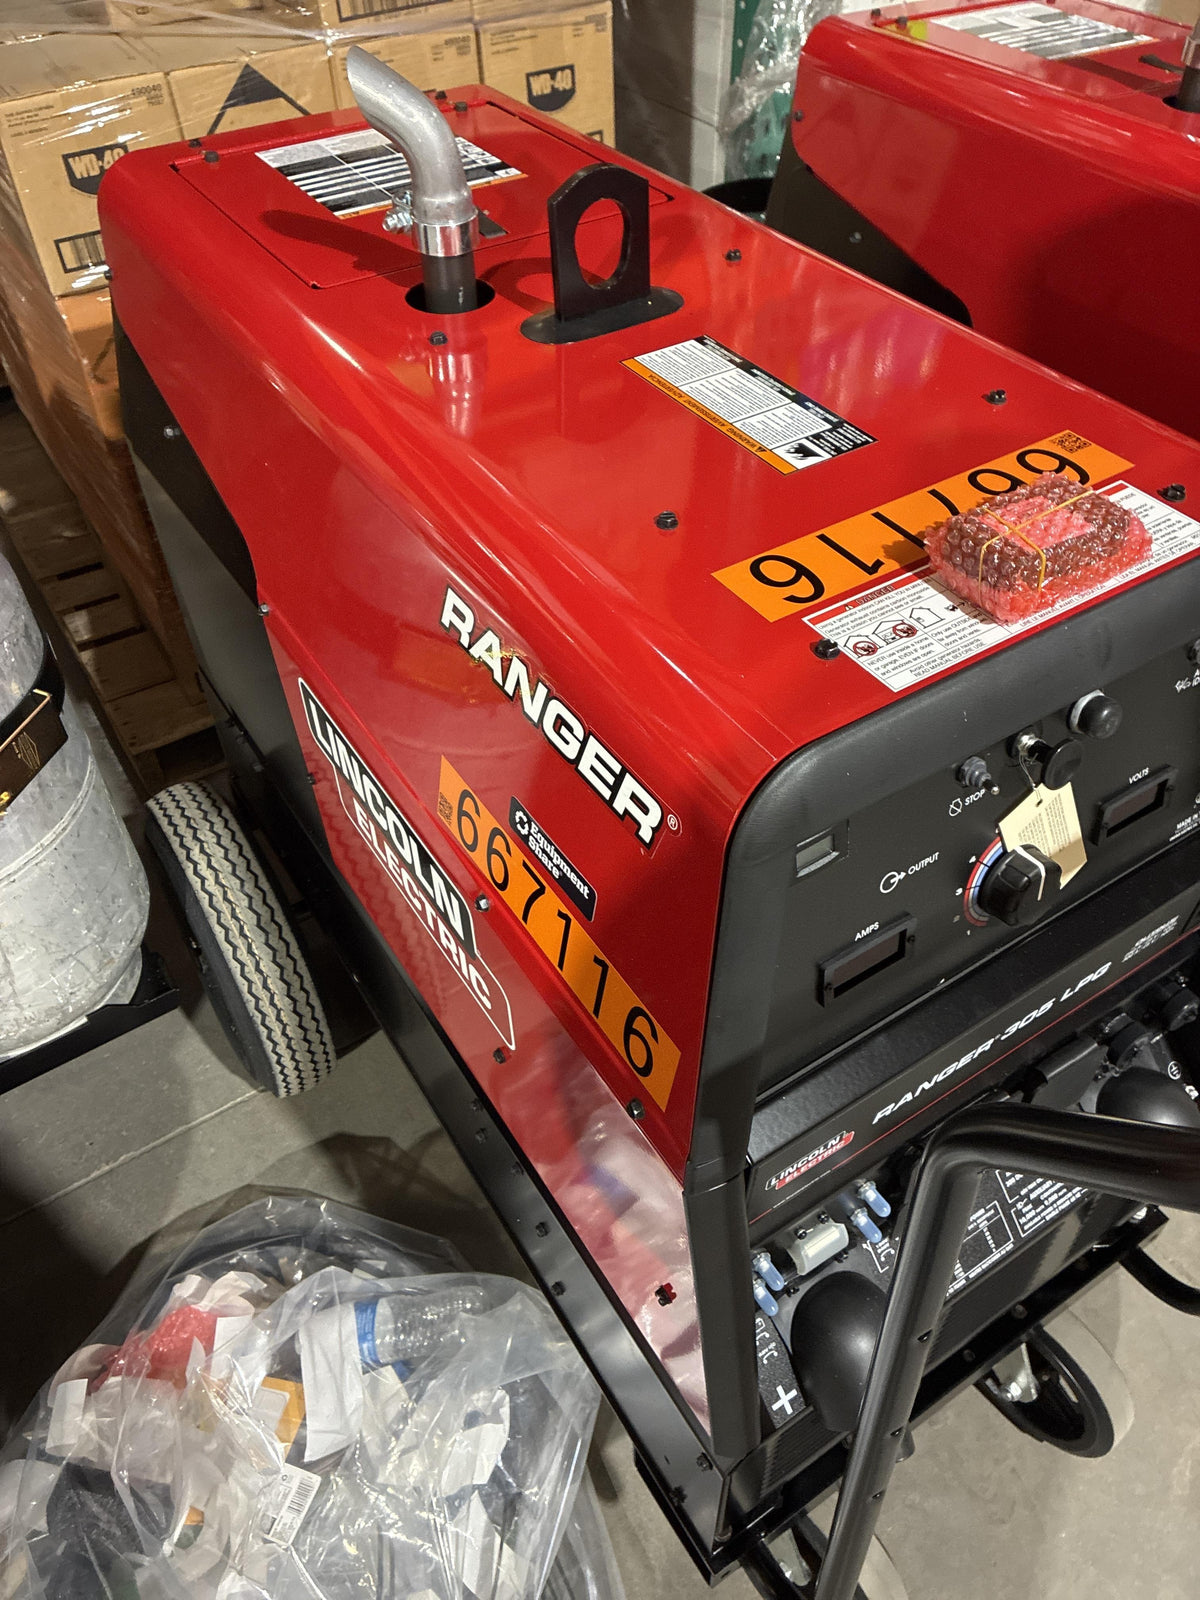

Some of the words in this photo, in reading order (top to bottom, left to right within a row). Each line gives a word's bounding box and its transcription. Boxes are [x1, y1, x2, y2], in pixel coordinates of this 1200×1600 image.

[528, 67, 573, 98] WD-40
[854, 584, 896, 604] DANGER
[835, 610, 859, 622] generator
[866, 655, 888, 667] NEVER
[898, 650, 916, 660] EVEN
[913, 667, 931, 677] READ
[928, 657, 953, 670] MANUAL
[950, 646, 975, 659] BEFORE
[936, 646, 962, 661] generator
[1128, 766, 1151, 785] VOLTS
[964, 788, 987, 807] STOP
[308, 698, 465, 941] LINCOLN
[530, 821, 591, 900] Equipment
[907, 851, 940, 876] OUTPUT
[353, 798, 491, 1009] ELECTRIC
[457, 789, 659, 1079] 667116
[854, 921, 880, 942] AMPS
[1000, 998, 1057, 1041] 305
[1060, 961, 1113, 1002] LPG
[770, 1135, 842, 1187] LINCOLN
[785, 1140, 846, 1184] ELECTRIC
